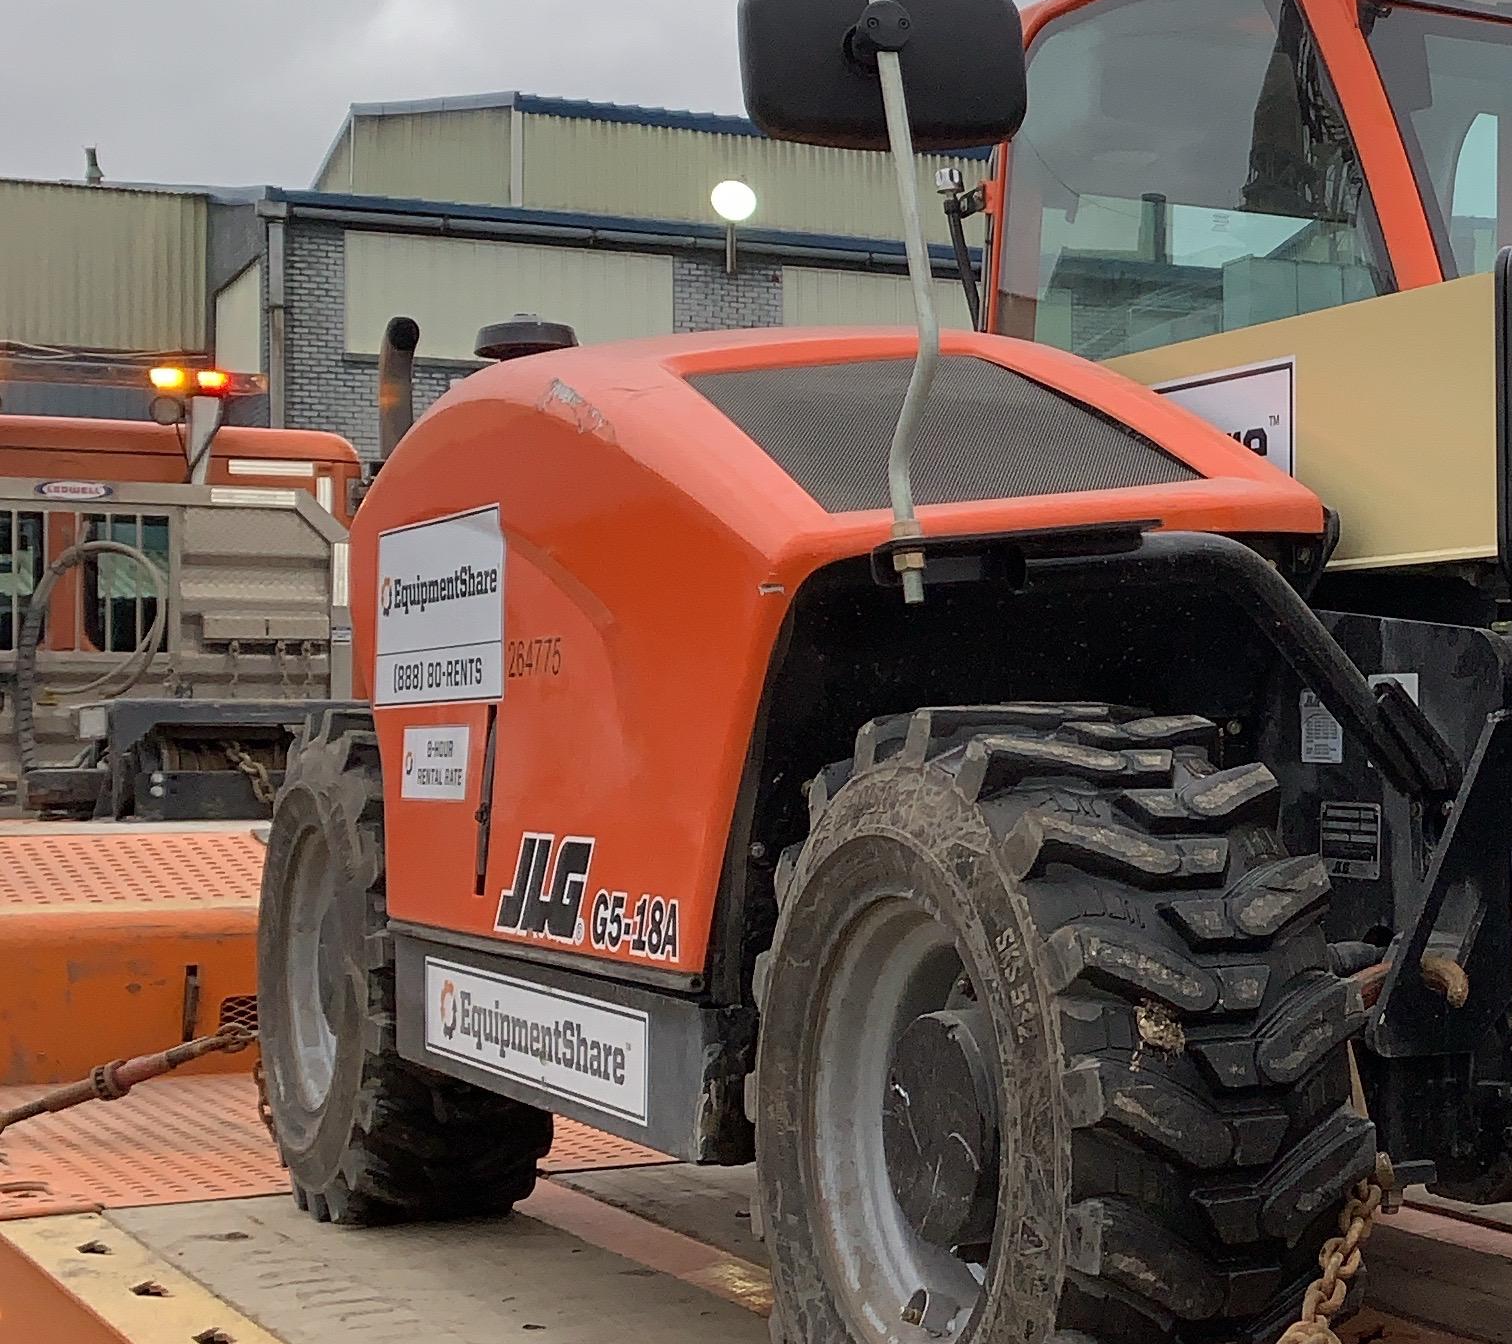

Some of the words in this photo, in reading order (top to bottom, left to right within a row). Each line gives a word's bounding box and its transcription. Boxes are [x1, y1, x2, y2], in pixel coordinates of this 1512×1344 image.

[393, 565, 498, 615] EquipmentShare
[393, 663, 424, 694] (888)
[427, 657, 483, 689] 80-RENTS
[507, 638, 562, 678] 264775
[494, 832, 595, 944] JLG
[590, 888, 680, 963] G5-18A
[459, 990, 628, 1086] EquipmentShare
